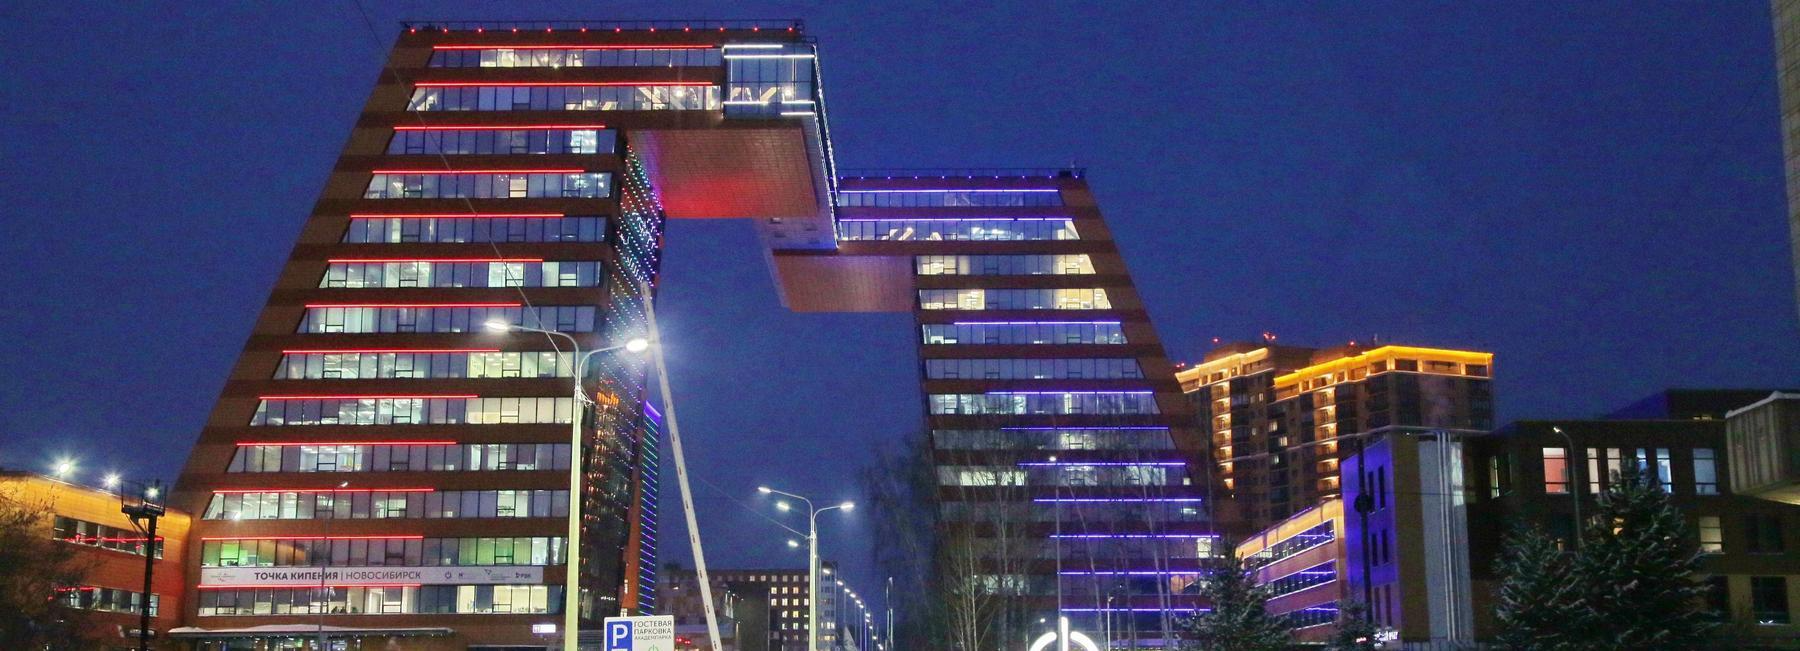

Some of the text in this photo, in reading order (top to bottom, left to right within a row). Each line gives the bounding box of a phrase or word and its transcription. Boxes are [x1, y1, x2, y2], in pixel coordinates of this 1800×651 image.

[254, 571, 421, 580] ТОЧКА КИПЕНИЯ НОВОСИБИРСК
[634, 620, 672, 628] ГОСТЕВАЯ
